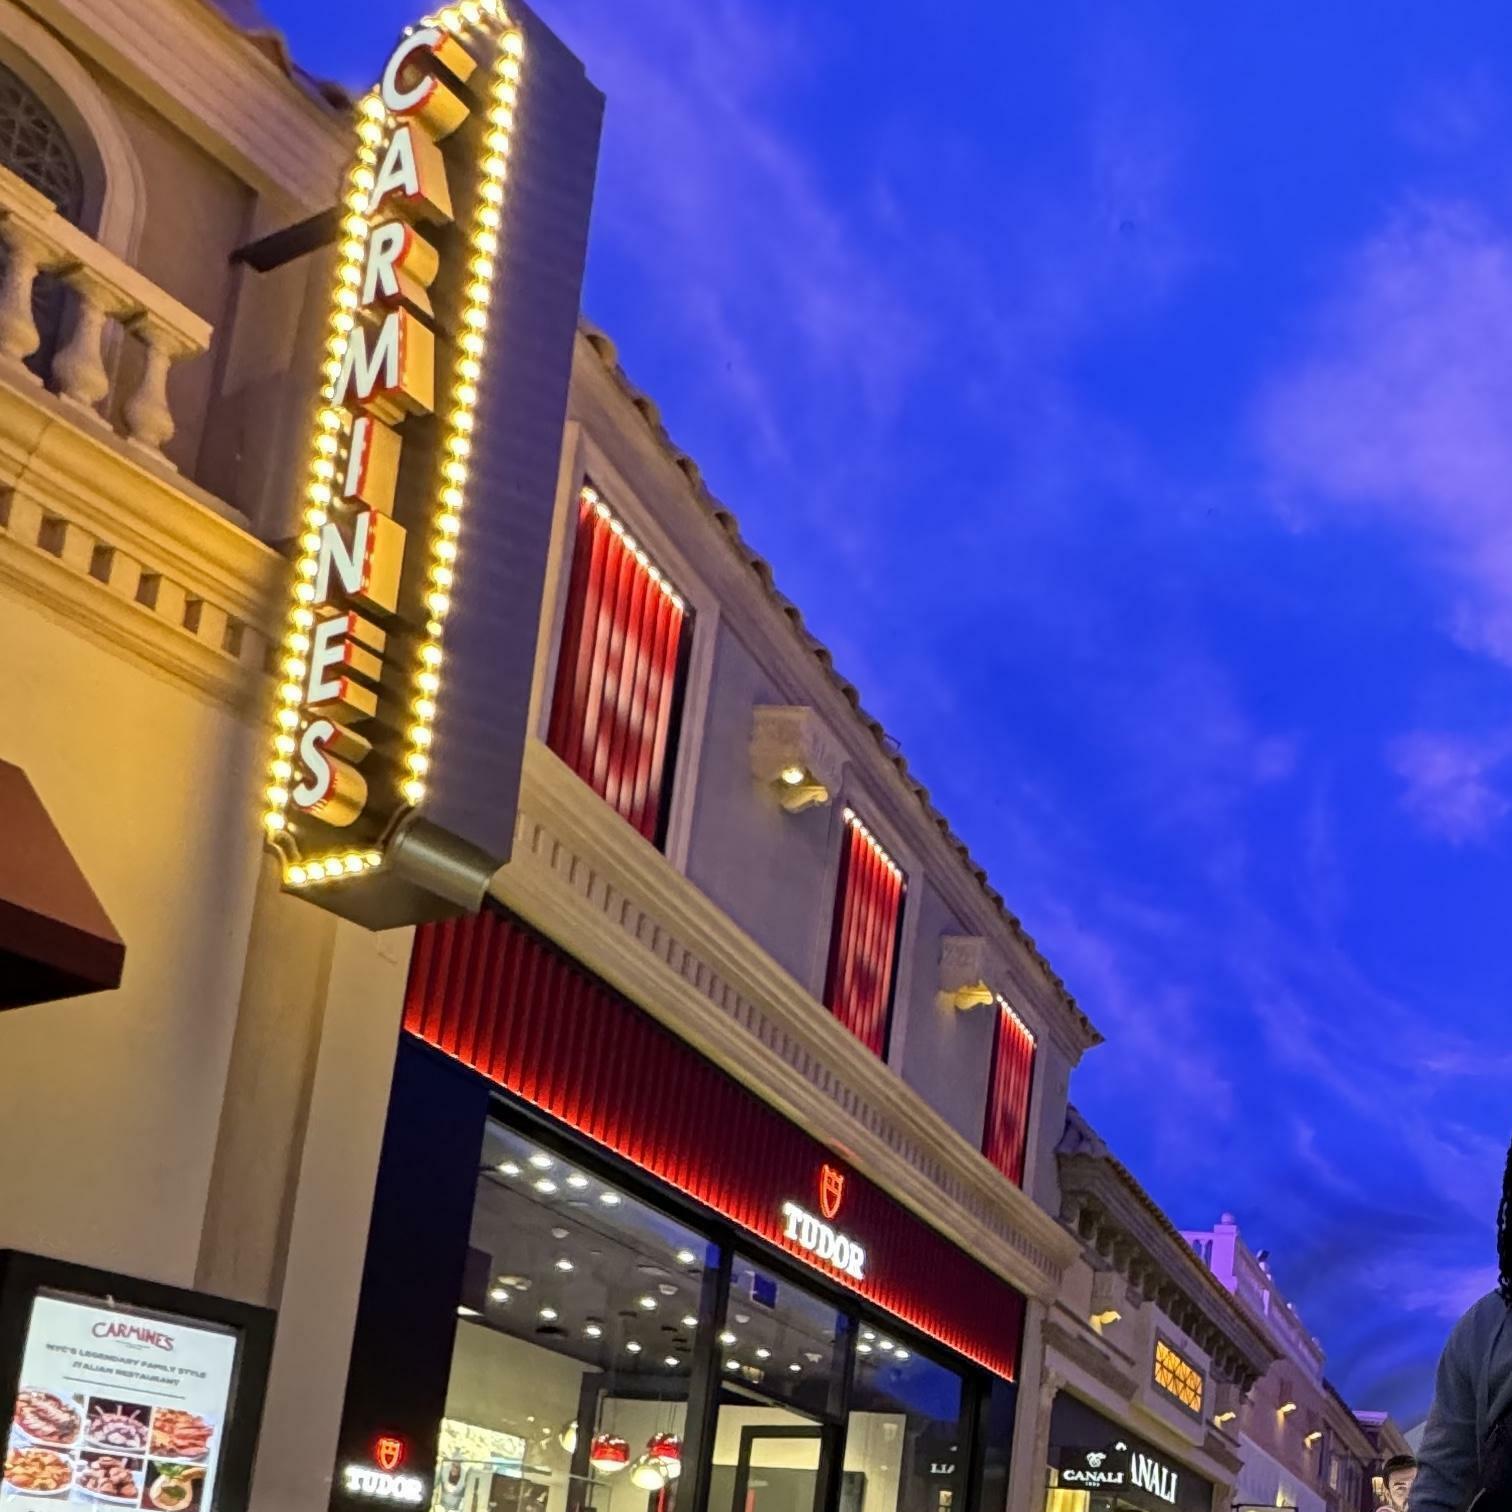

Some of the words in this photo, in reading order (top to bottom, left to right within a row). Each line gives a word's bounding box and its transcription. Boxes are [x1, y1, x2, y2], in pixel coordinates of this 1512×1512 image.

[783, 1202, 866, 1280] TUDOR
[72, 1361, 113, 1374] ITALIAN
[115, 1368, 180, 1386] RESTAURANT
[79, 1349, 139, 1366] LEGENDARY
[141, 1360, 176, 1373] FAMILY
[178, 1367, 206, 1379] STYLE
[344, 1466, 424, 1502] TUDOR
[1063, 1469, 1124, 1484] CANALI
